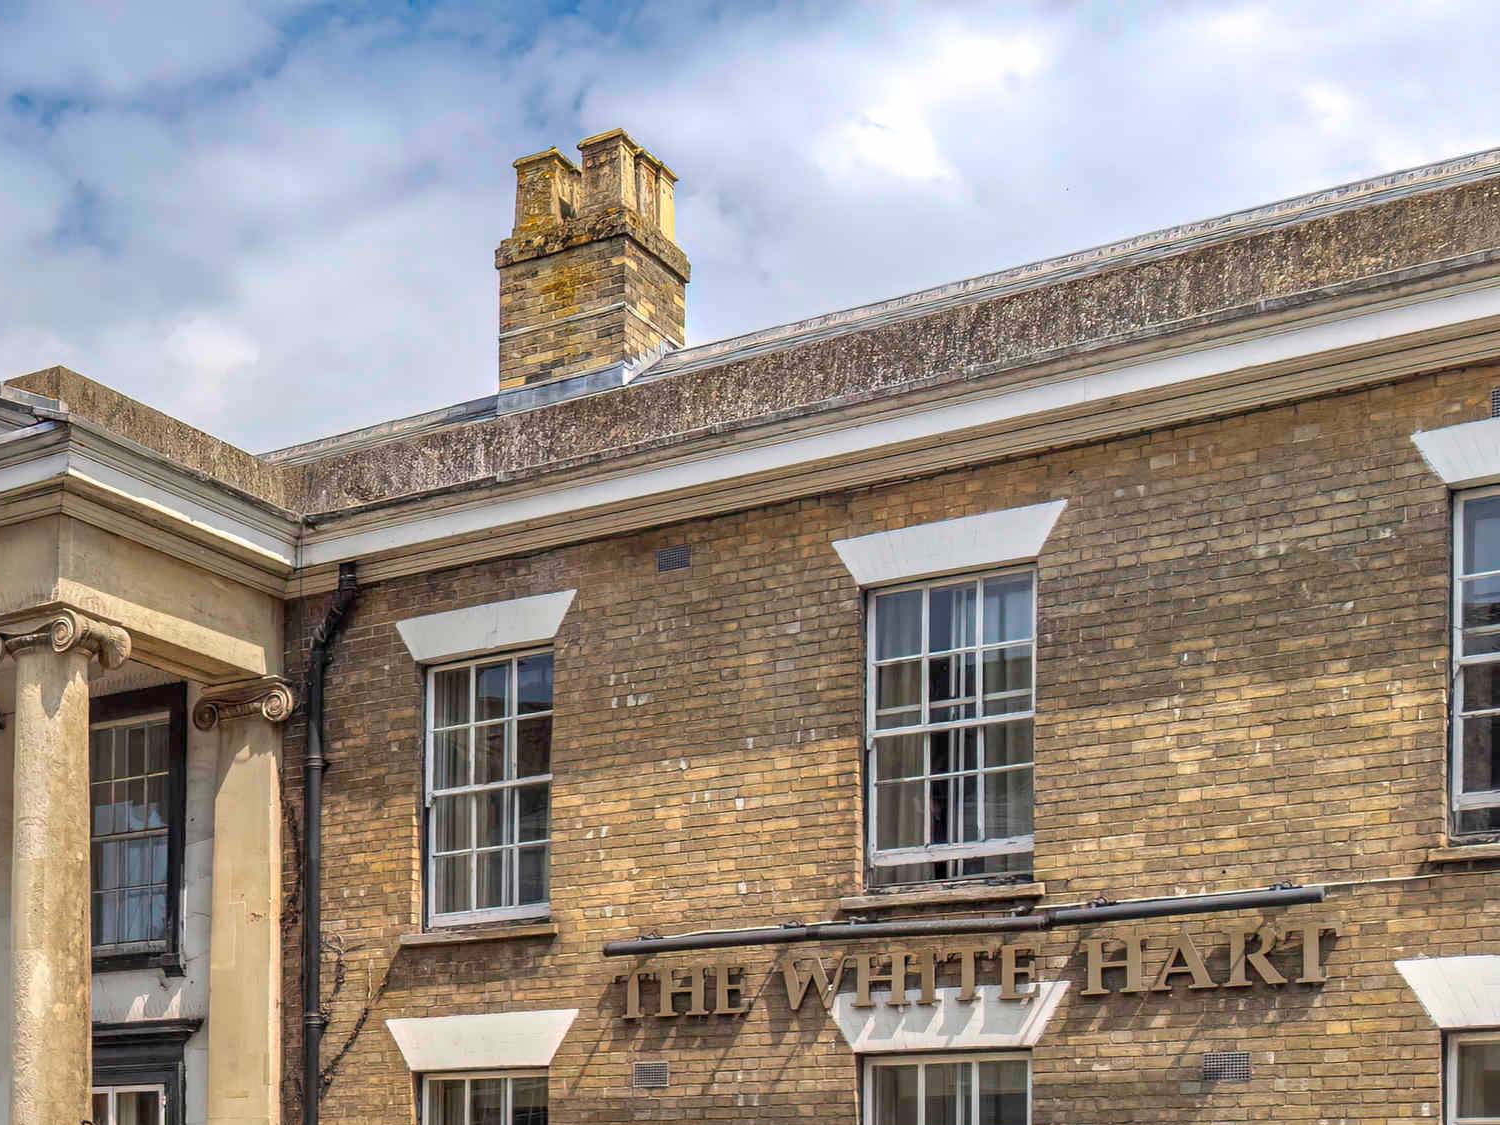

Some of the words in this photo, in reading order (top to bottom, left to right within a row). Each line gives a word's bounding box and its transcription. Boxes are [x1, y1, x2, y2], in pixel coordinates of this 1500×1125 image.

[614, 963, 748, 1020] THE
[779, 942, 1041, 1011] WHITE
[1080, 923, 1342, 997] HART
